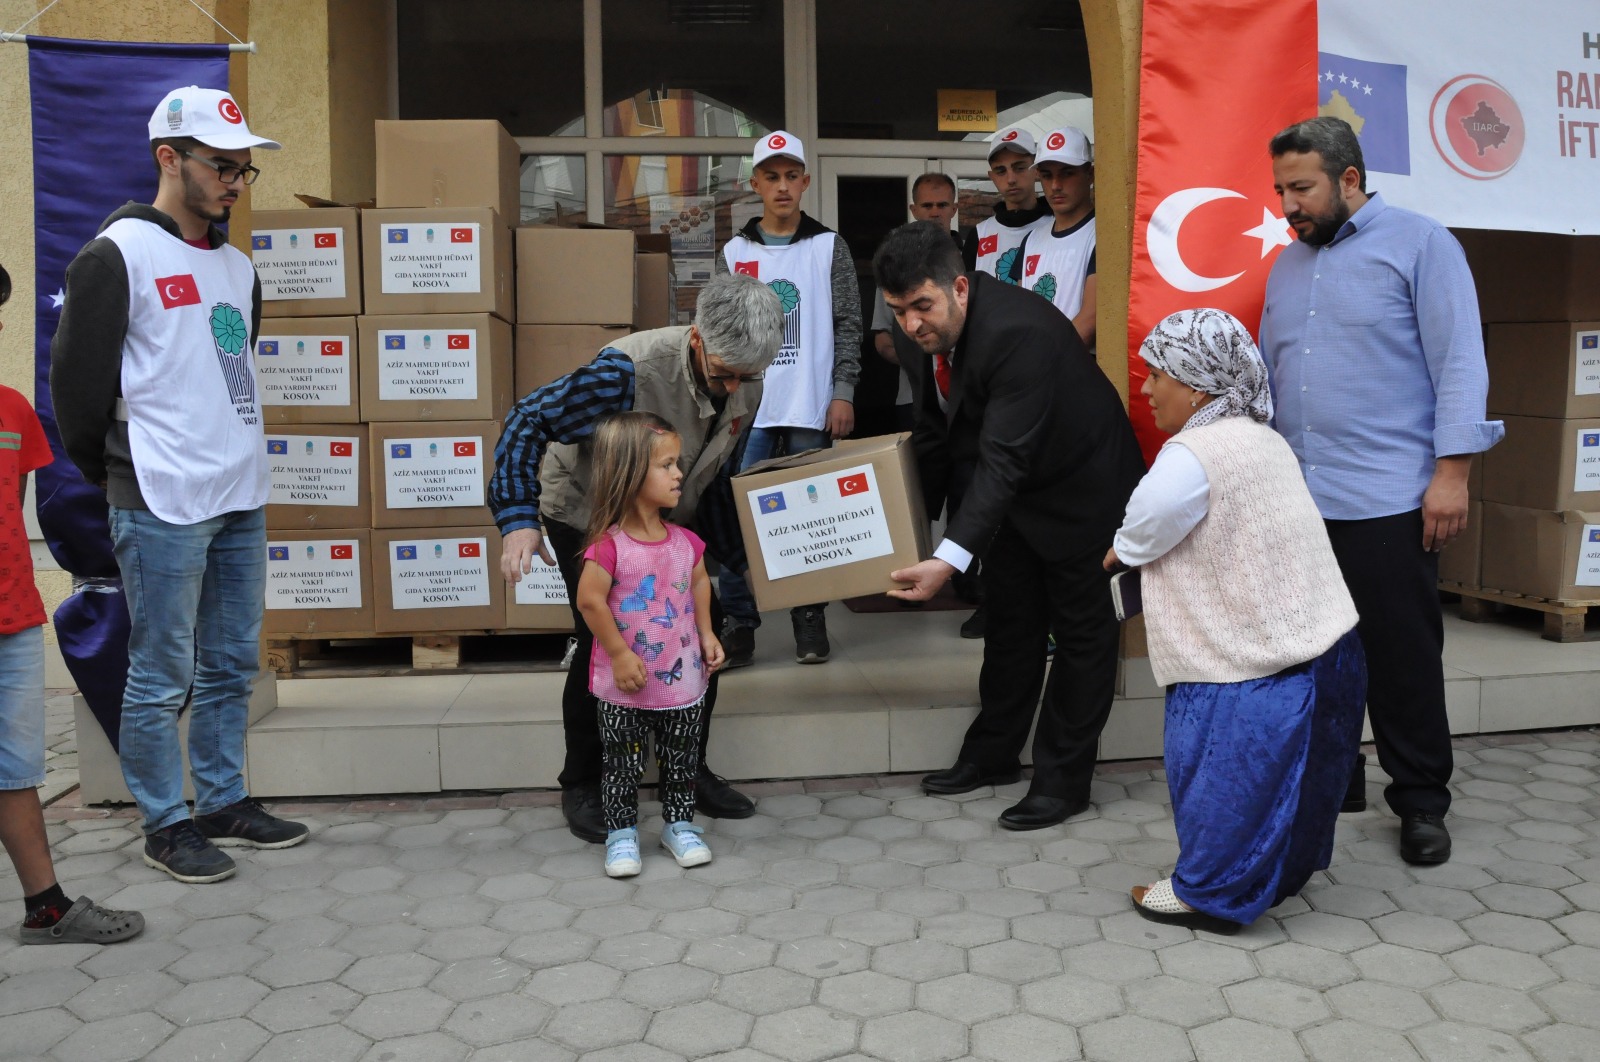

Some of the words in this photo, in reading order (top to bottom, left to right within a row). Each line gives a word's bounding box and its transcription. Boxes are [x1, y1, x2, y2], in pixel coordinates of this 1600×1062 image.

[412, 280, 450, 288] KOSOVA
[277, 286, 316, 294] KOSOVA
[776, 350, 799, 358] DÂYİ
[409, 387, 447, 395] KOSOVA
[282, 393, 320, 401] KOSOVA
[242, 416, 258, 426] VAKF
[412, 468, 447, 476] MAHMUD
[289, 492, 328, 500] KOSOVA
[416, 494, 455, 502] KOSOVA
[767, 527, 791, 538] AZİZ
[791, 516, 836, 532] MAHMUD
[836, 506, 875, 523] HÜDAYİ
[807, 527, 837, 539] VAKFİ
[779, 548, 802, 557] GIDA
[802, 539, 838, 552] YARDIM
[839, 530, 873, 545] PAKETİ
[804, 548, 853, 565] KOSOVA
[270, 570, 290, 578] AZİZ
[290, 570, 324, 578] MAHMUD
[398, 570, 417, 578] AZİZ
[418, 569, 452, 577] MAHMUD
[531, 566, 540, 574] İZ
[422, 594, 460, 602] KOSOVA
[544, 591, 570, 599] KOSO
[294, 595, 332, 604] KOSOVA
